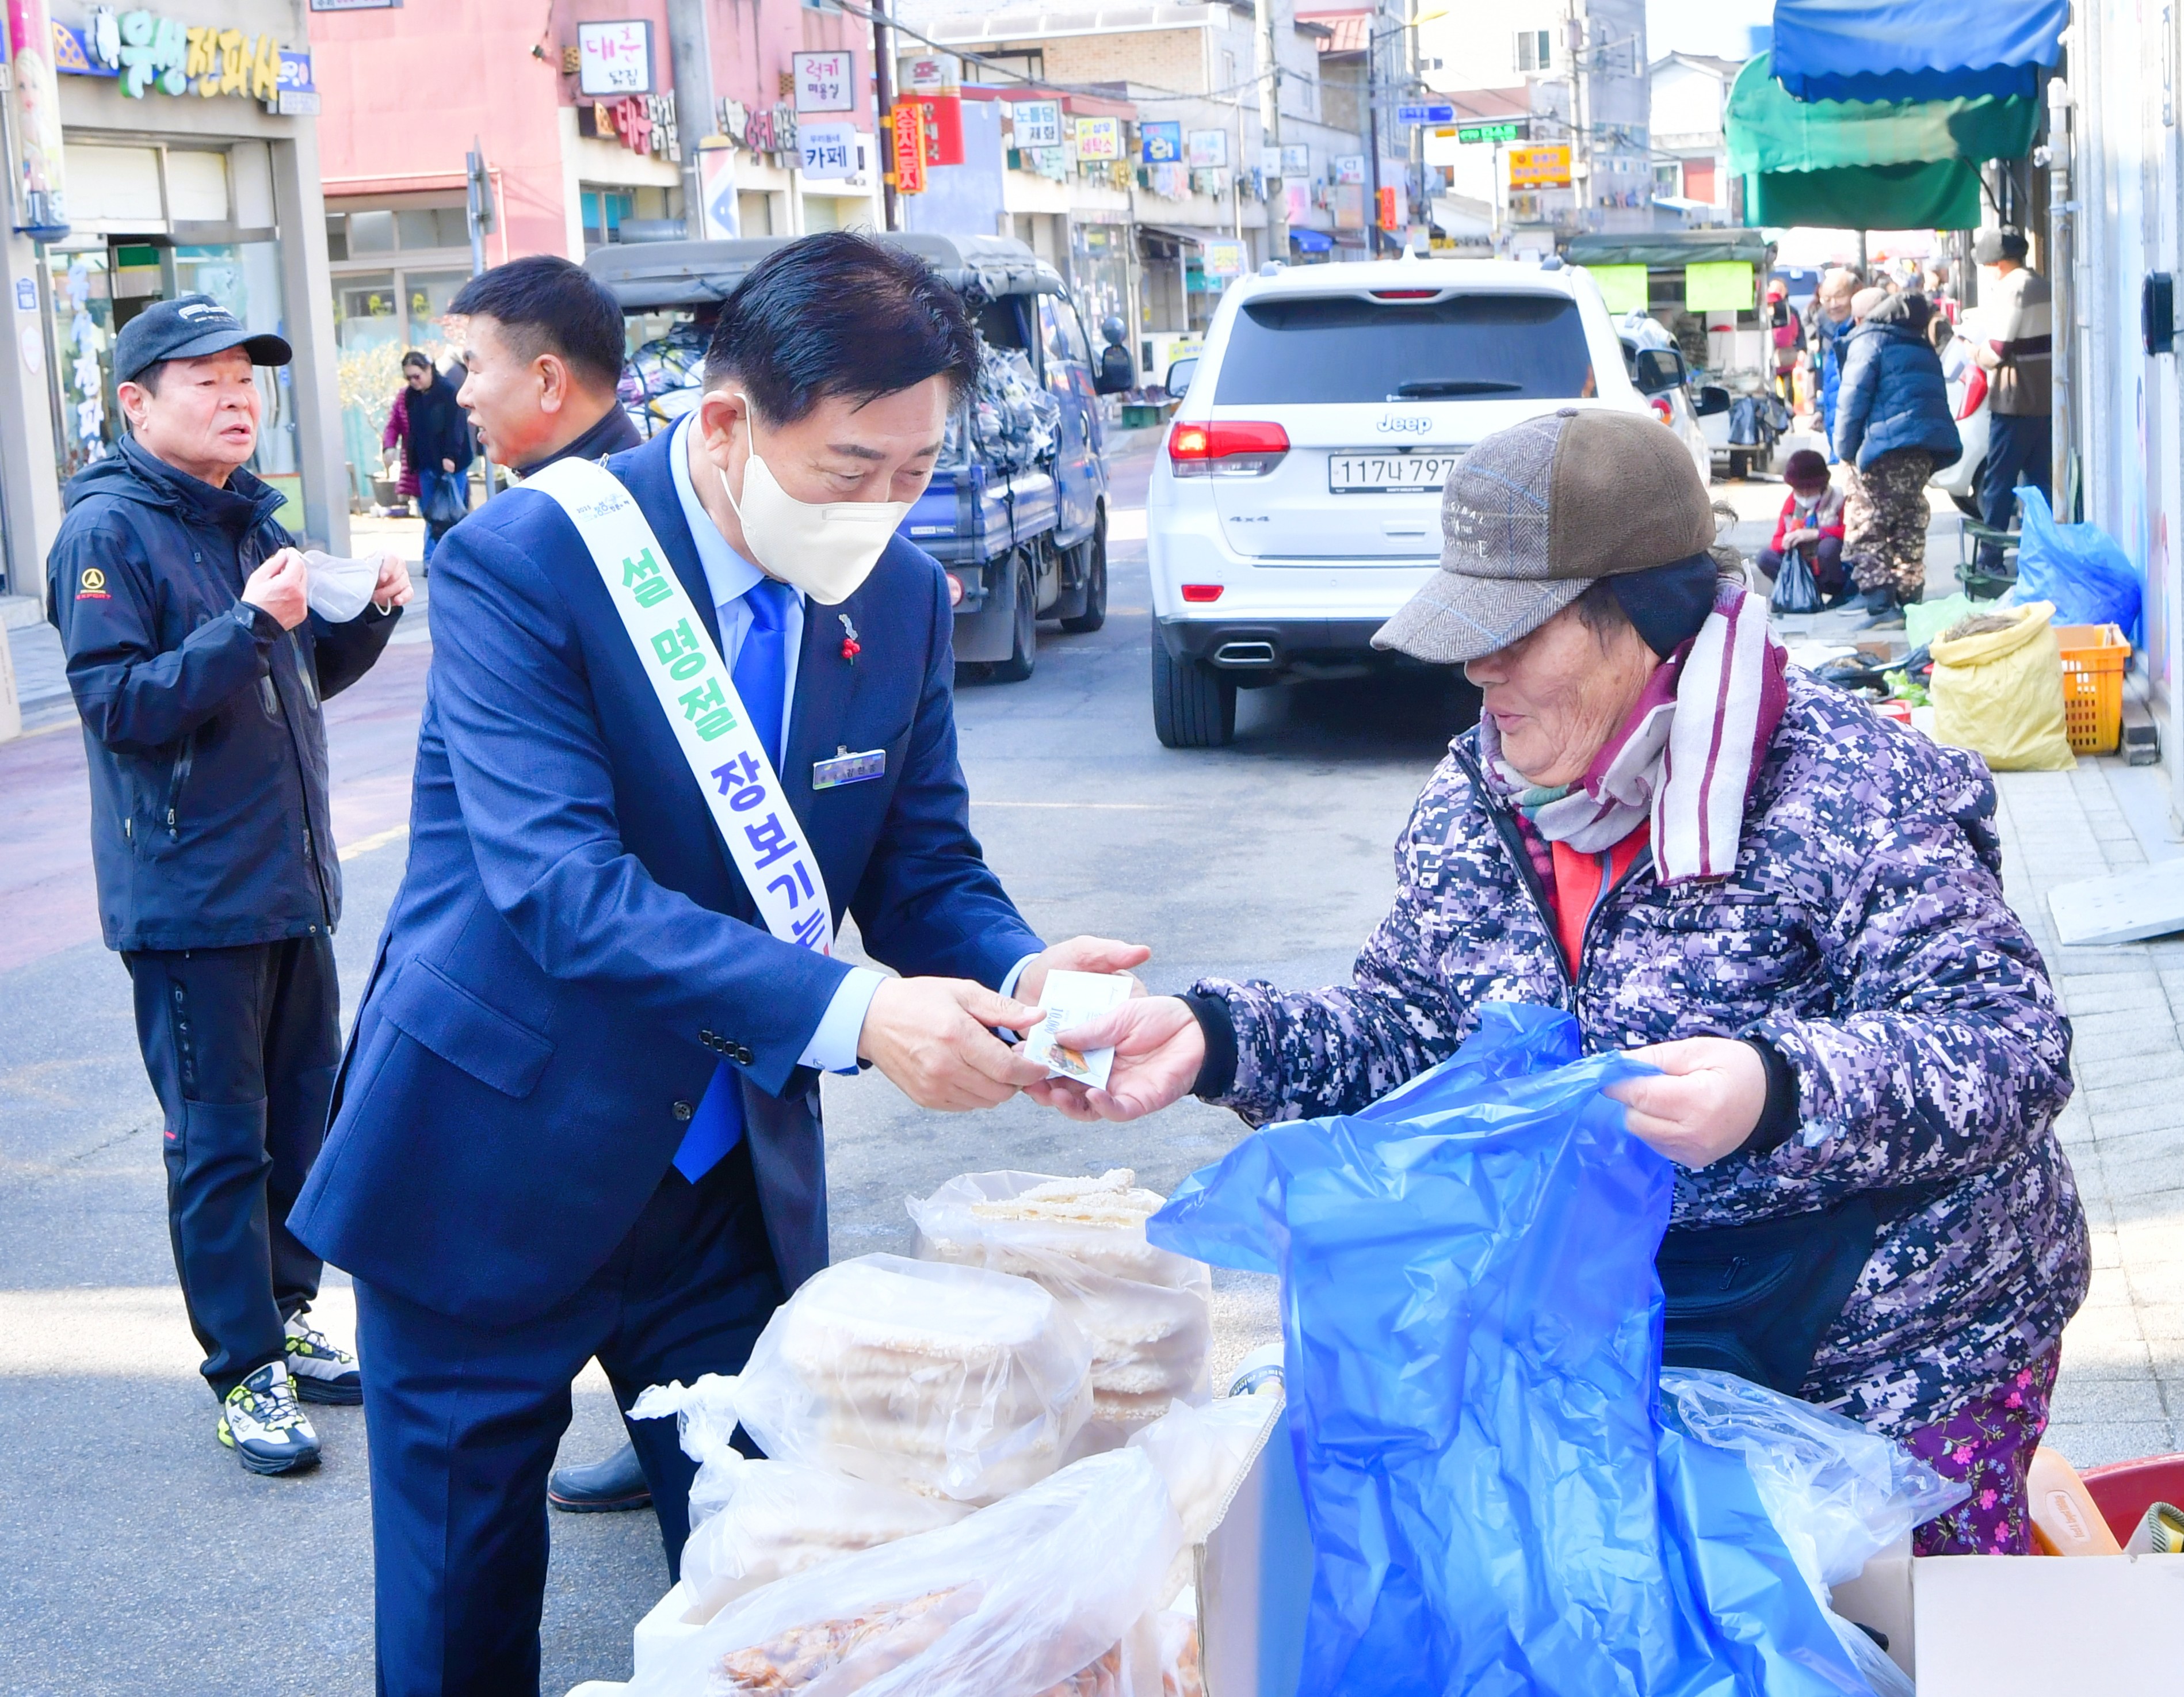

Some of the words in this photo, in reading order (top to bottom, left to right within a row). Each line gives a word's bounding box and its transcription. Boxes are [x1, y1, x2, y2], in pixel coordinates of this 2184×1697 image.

[609, 69, 637, 86] 닭집
[806, 58, 839, 81] 럭키
[808, 83, 839, 100] 미용실
[806, 146, 847, 169] 카페
[1377, 414, 1432, 434] Jeep
[1341, 460, 1403, 483] 117나
[622, 547, 675, 609] 설
[651, 617, 738, 742] 명절
[1044, 1007, 1063, 1035] 10,000
